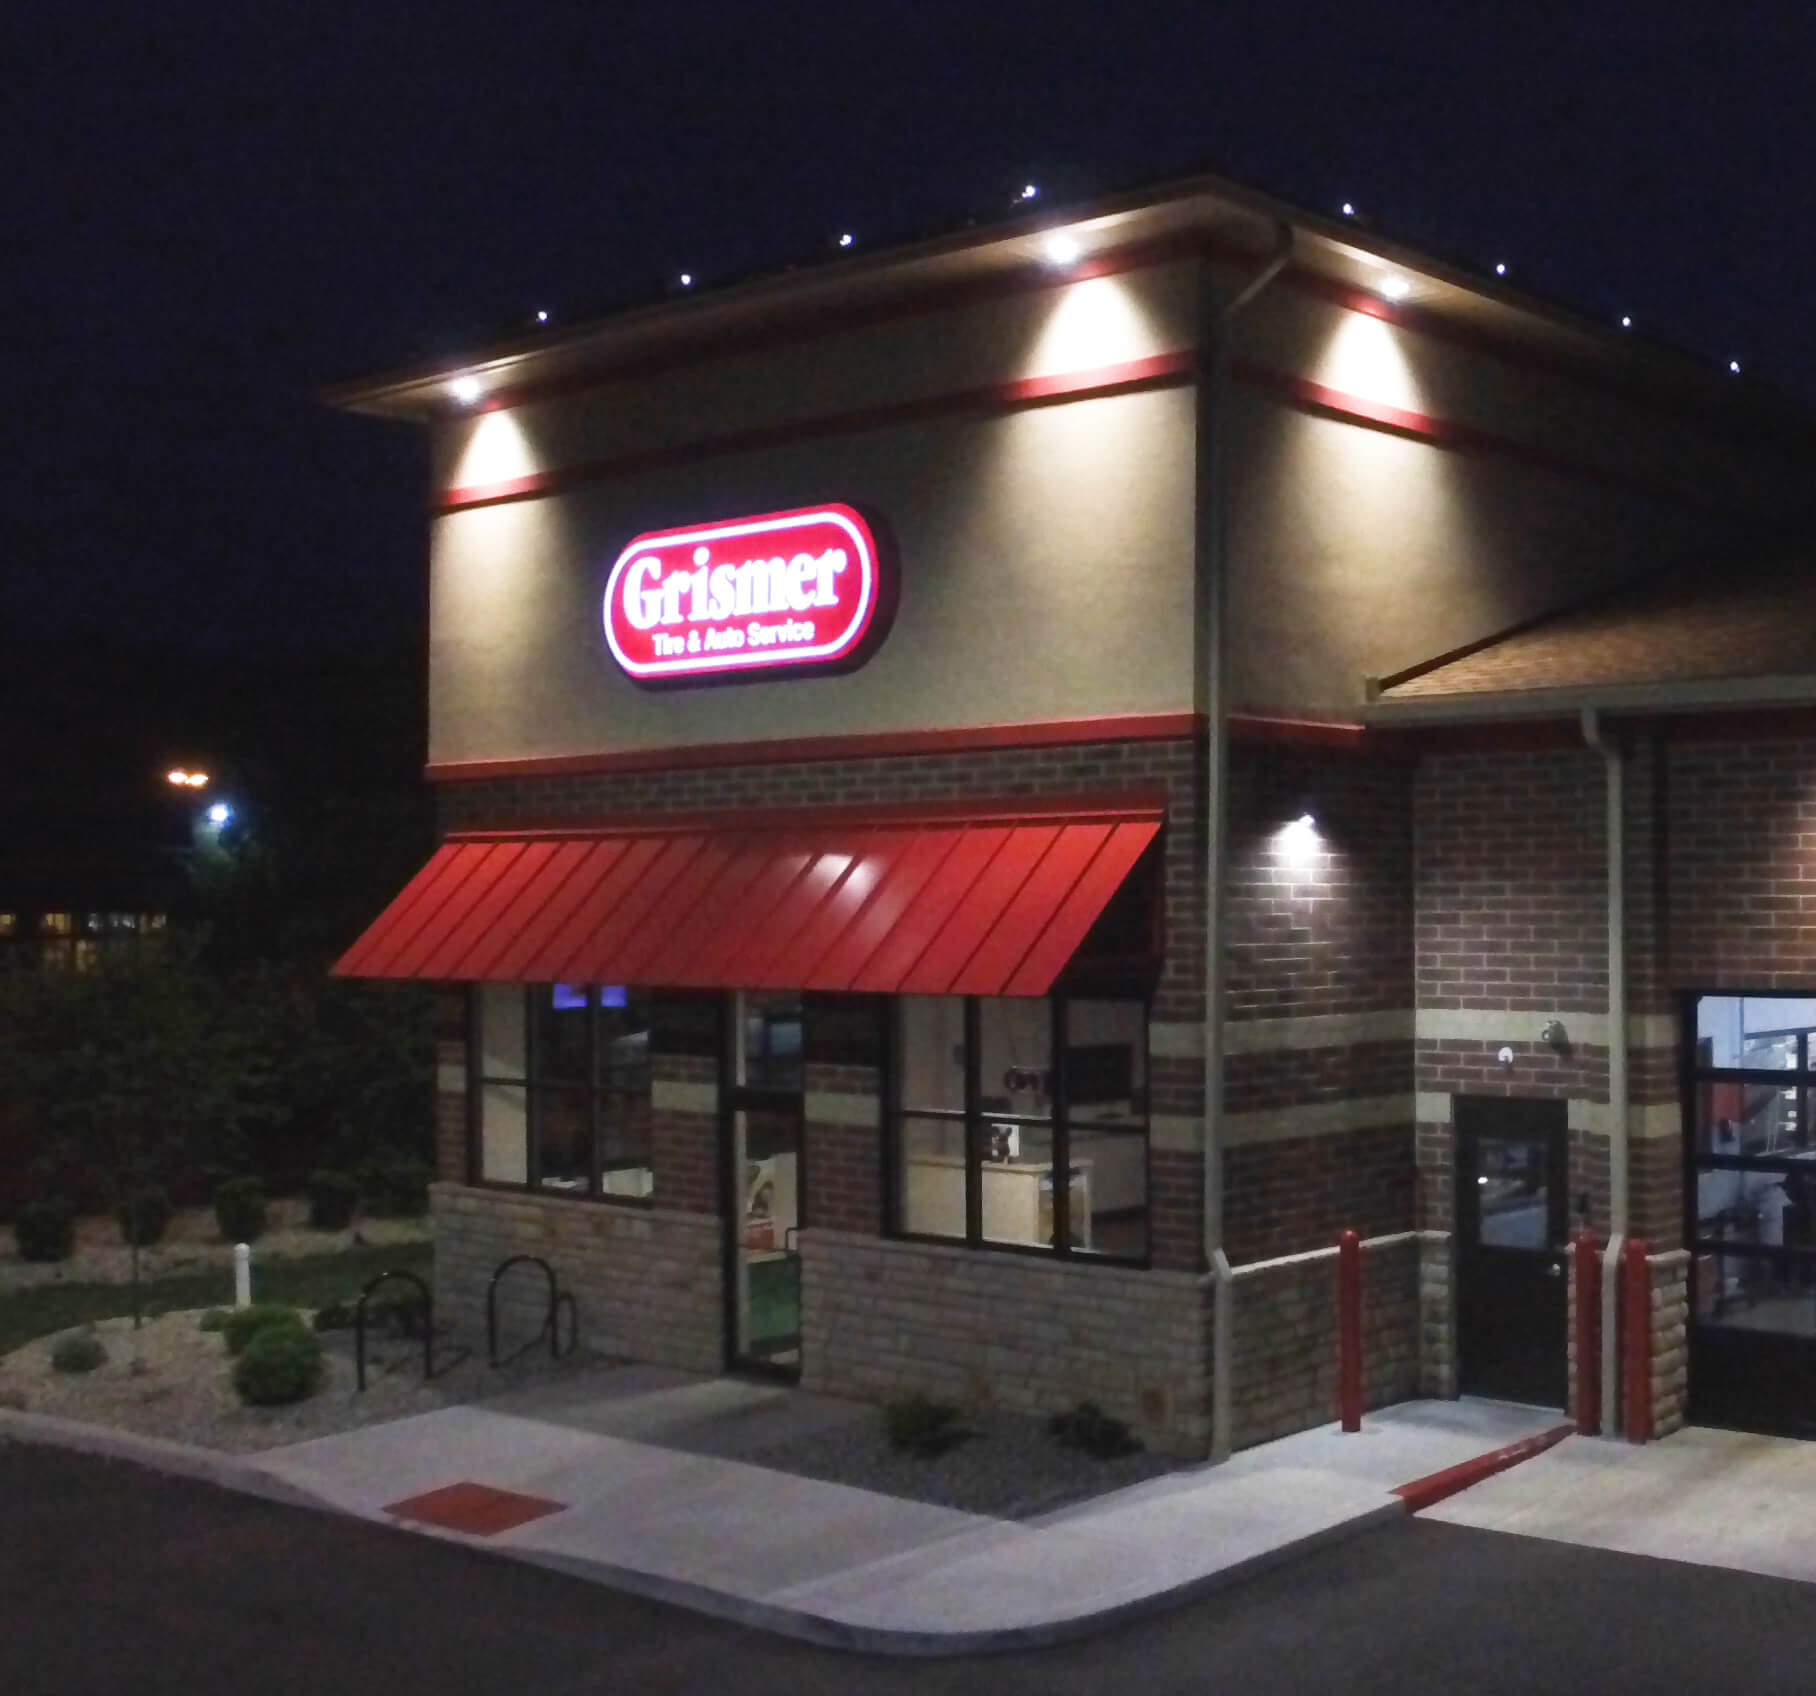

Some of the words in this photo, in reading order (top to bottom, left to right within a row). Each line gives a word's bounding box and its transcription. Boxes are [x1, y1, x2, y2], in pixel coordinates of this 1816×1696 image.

[623, 547, 847, 629] Grismer
[652, 632, 685, 656] Tire
[687, 630, 701, 653] &
[704, 626, 745, 650] Auto
[747, 618, 815, 646] Service
